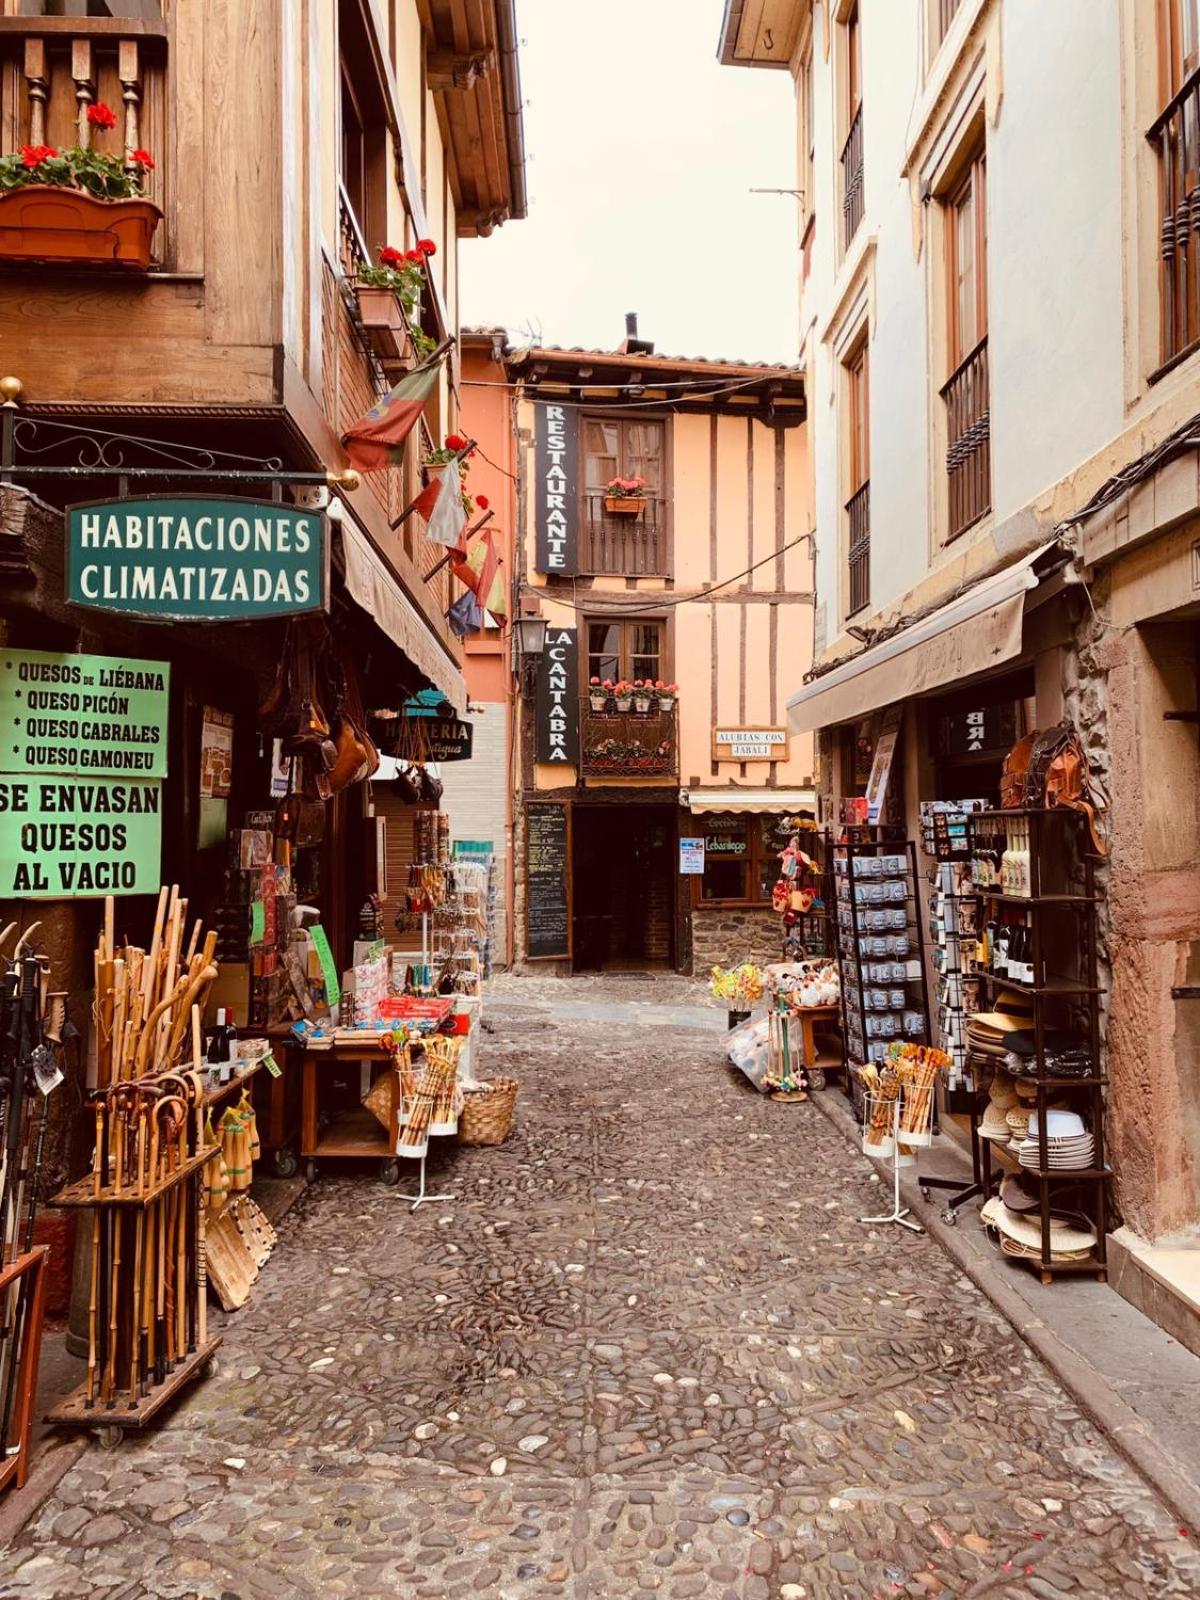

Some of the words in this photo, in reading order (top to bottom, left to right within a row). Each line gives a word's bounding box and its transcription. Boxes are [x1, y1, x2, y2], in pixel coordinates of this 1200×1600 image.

[546, 405, 567, 568] RESTAURANTE
[80, 514, 311, 553] HABITACIONES
[80, 565, 310, 602] CLIMATIZADAS
[545, 631, 573, 645] LA
[18, 662, 81, 684] QUESOS
[99, 665, 164, 691] LIÉBANA
[27, 690, 79, 711] QUESO
[82, 692, 129, 715] PICÓN
[549, 648, 568, 761] CANTABRA
[26, 718, 78, 739] QUESO
[81, 721, 160, 744] CABRALES
[385, 722, 469, 740] HTERIA
[718, 733, 760, 742] ALUBIAS
[765, 733, 783, 742] CON
[25, 745, 77, 766] QUESO
[80, 748, 154, 770] GAMONEU
[0, 783, 28, 813] SE
[39, 785, 159, 814] ENVASAN
[21, 823, 127, 854] QUESOS
[13, 863, 49, 891] AL
[58, 861, 136, 890] VACIO
